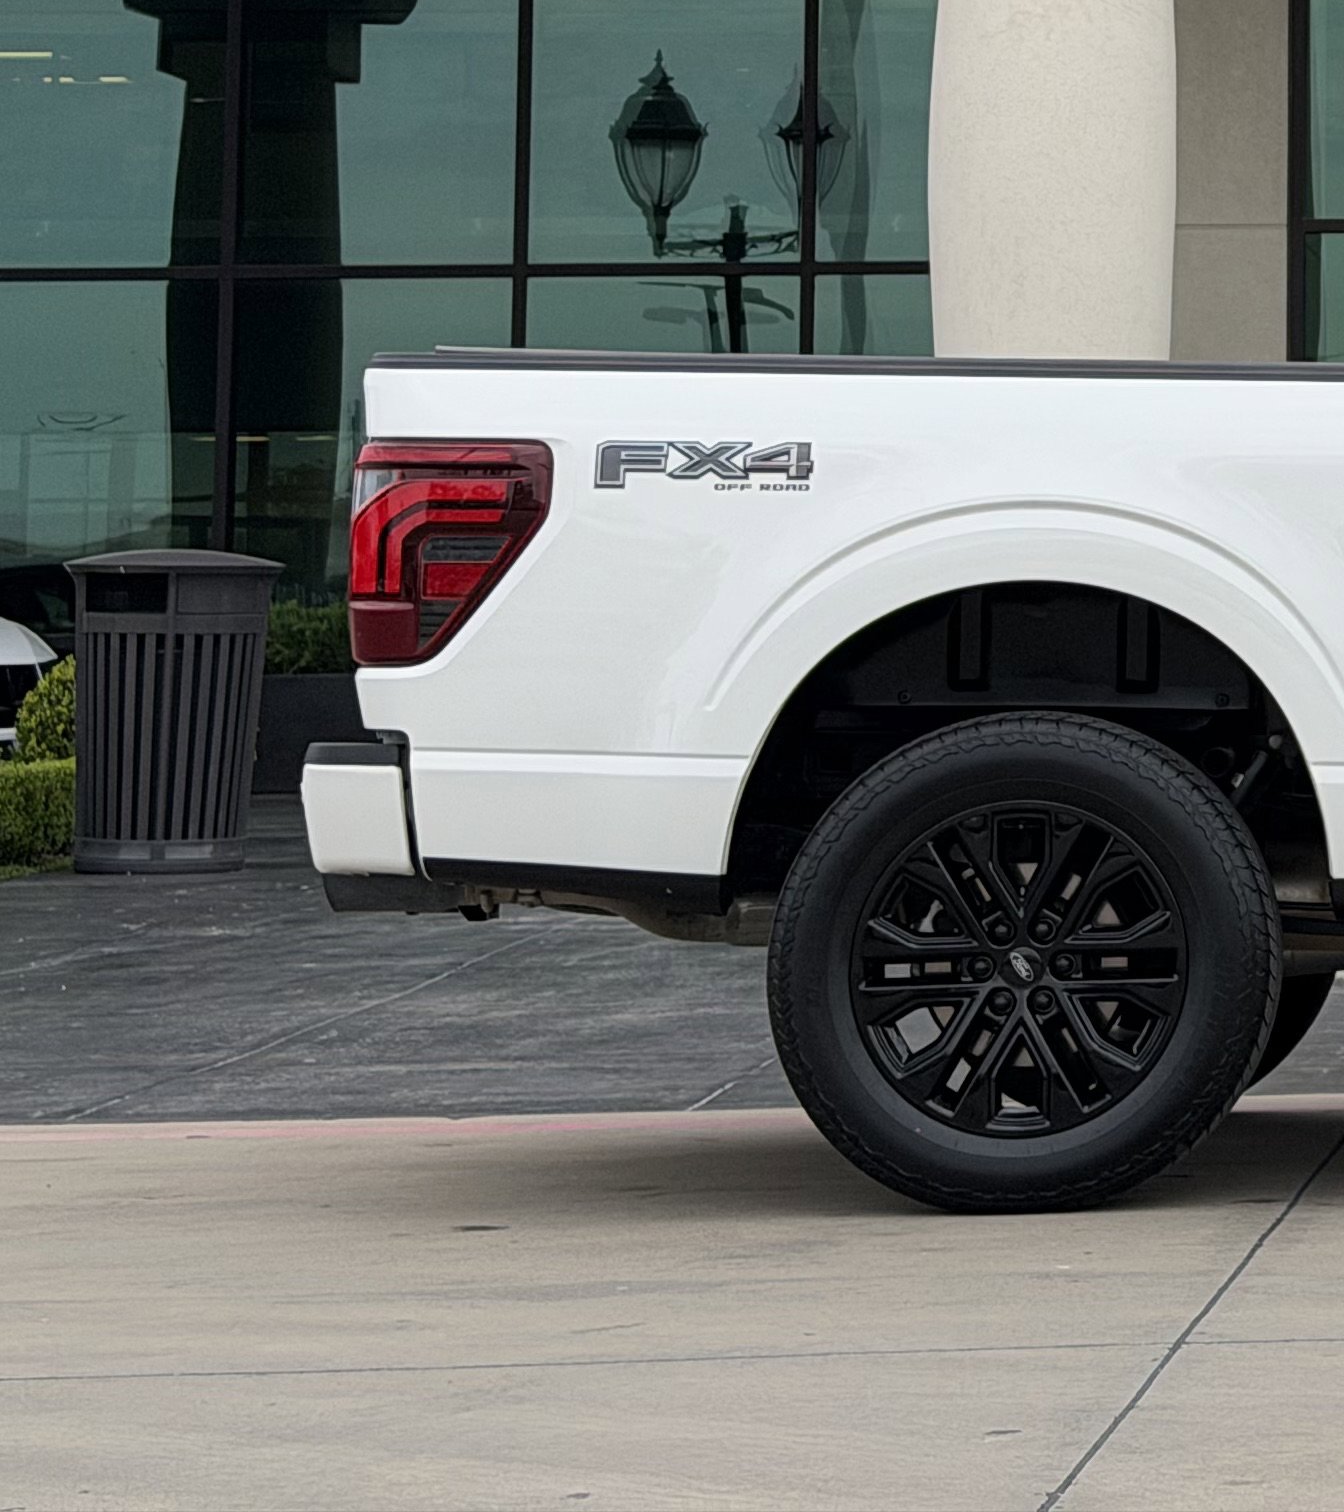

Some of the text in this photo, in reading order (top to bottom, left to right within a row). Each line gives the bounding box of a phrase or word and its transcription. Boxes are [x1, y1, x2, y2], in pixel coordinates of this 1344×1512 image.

[593, 440, 814, 489] FX4
[713, 483, 811, 492] OFF ROAD
